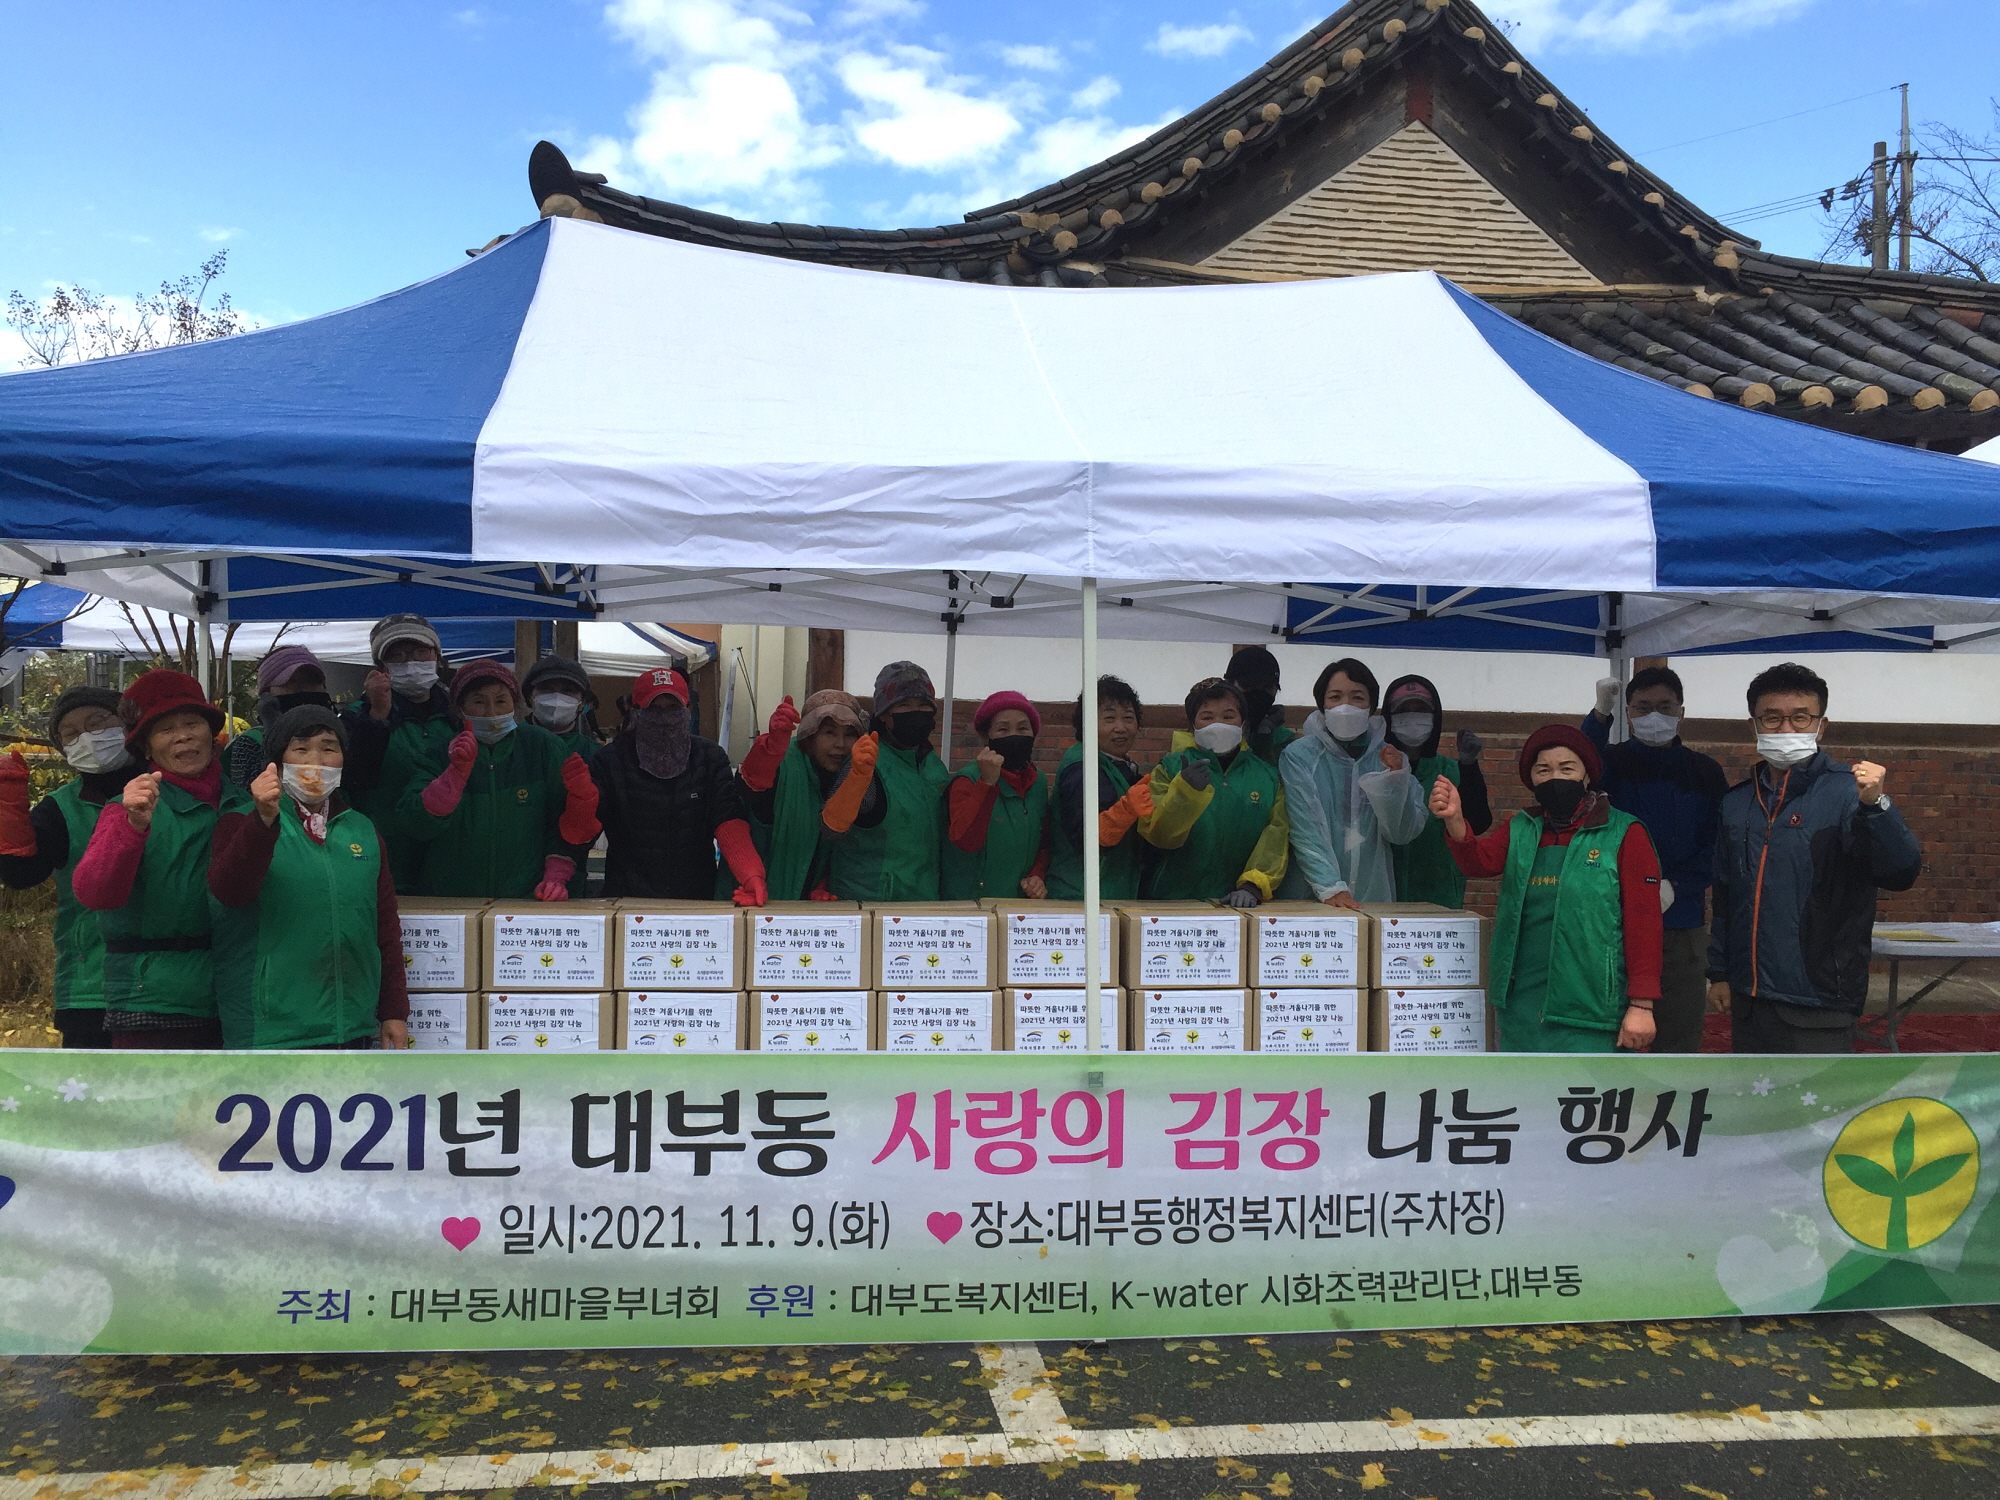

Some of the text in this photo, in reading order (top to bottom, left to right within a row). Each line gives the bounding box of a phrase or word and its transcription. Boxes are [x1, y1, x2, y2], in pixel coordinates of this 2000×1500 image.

[652, 670, 673, 686] H
[425, 929, 440, 937] 위한
[500, 928, 523, 936] 따뜻한
[526, 928, 562, 936] 겨울나기를
[631, 929, 710, 937] 따뜻한 겨울나기를 위한
[760, 928, 838, 937] 따뜻한 겨울나기를 위한
[888, 929, 964, 937] 따뜻한 겨울나기를 위한
[1013, 926, 1034, 935] 따뜻한
[1038, 927, 1071, 935] 겨울나기를
[1147, 929, 1219, 937] 따뜻한 겨울나기를 위한
[1265, 930, 1336, 938] 따뜻한 겨울나기를 위한
[1387, 931, 1459, 939] 따뜻한 겨울나기를 위한
[415, 940, 430, 949] 김장
[433, 940, 448, 948] 나눔
[500, 939, 588, 948] 2021년 사랑의 김장 나눔
[660, 941, 682, 949] 사랑의
[686, 941, 700, 949] 김장
[703, 941, 717, 949] 나눔
[761, 940, 786, 948] 2021년
[789, 940, 810, 948] 사랑의
[814, 940, 828, 948] 김장
[941, 940, 955, 949] 김장
[1013, 938, 1078, 946] 2021년 사랑의 김장
[1147, 940, 1225, 948] 2021년 사랑의 김장 나눔
[1265, 941, 1343, 949] 2021년 사랑의 김장 나눔
[1452, 941, 1466, 950] 나눔
[1044, 1005, 1078, 1013] 겨울나기를
[1150, 1006, 1170, 1014] 따뜻한
[1174, 1006, 1206, 1014] 겨울나기를
[1266, 1004, 1286, 1013] 따뜻한
[1289, 1004, 1321, 1012] 겨울나기를
[1394, 1001, 1464, 1011] 따뜻한 겨울나기를 위한
[427, 1009, 442, 1017] 위한
[494, 1008, 574, 1016] 따뜻한 겨울나기를 위한
[634, 1008, 713, 1016] 따뜻한 겨울나기를 위한
[791, 1007, 826, 1015] 겨울나기를
[830, 1007, 844, 1015] 위한
[893, 1007, 969, 1016] 따뜻한 겨울나기를 위한
[1048, 1016, 1069, 1024] 사랑의
[1073, 1016, 1086, 1024] 김장
[1266, 1015, 1290, 1023] 2021년
[1331, 1014, 1343, 1022] 나눔
[1421, 1013, 1440, 1021] 사랑의
[1443, 1012, 1456, 1020] 김장
[1458, 1012, 1471, 1020] 나눔
[417, 1021, 432, 1029] 김장
[435, 1021, 450, 1029] 나눔
[494, 1020, 582, 1029] 2021년 사랑의 김장 나눔
[634, 1019, 720, 1028] 2021년 사랑의 김장 나눔
[767, 1018, 851, 1027] 2021년 사랑의 김장 나눔
[893, 1019, 976, 1027] 2021년 사랑의 김장 나눔
[1150, 1017, 1174, 1025] 2021년
[1177, 1017, 1197, 1025] 사랑의
[1201, 1017, 1214, 1025] 김장
[215, 1087, 1712, 1177] 2021년 대부동 사랑의 김장 나눔 행사
[500, 1205, 700, 1254] 일시:2021.
[721, 1205, 775, 1248] 11.
[793, 1201, 889, 1250] 9.(화)
[277, 1289, 350, 1324] 주최
[391, 1286, 718, 1322] 대부동새마을부녀회
[746, 1285, 813, 1318] 후원
[852, 1281, 1097, 1316] 대부도복지센터,
[1112, 1278, 1248, 1309] K-water
[1261, 1265, 1582, 1306] 시화조력관리단,대부동
